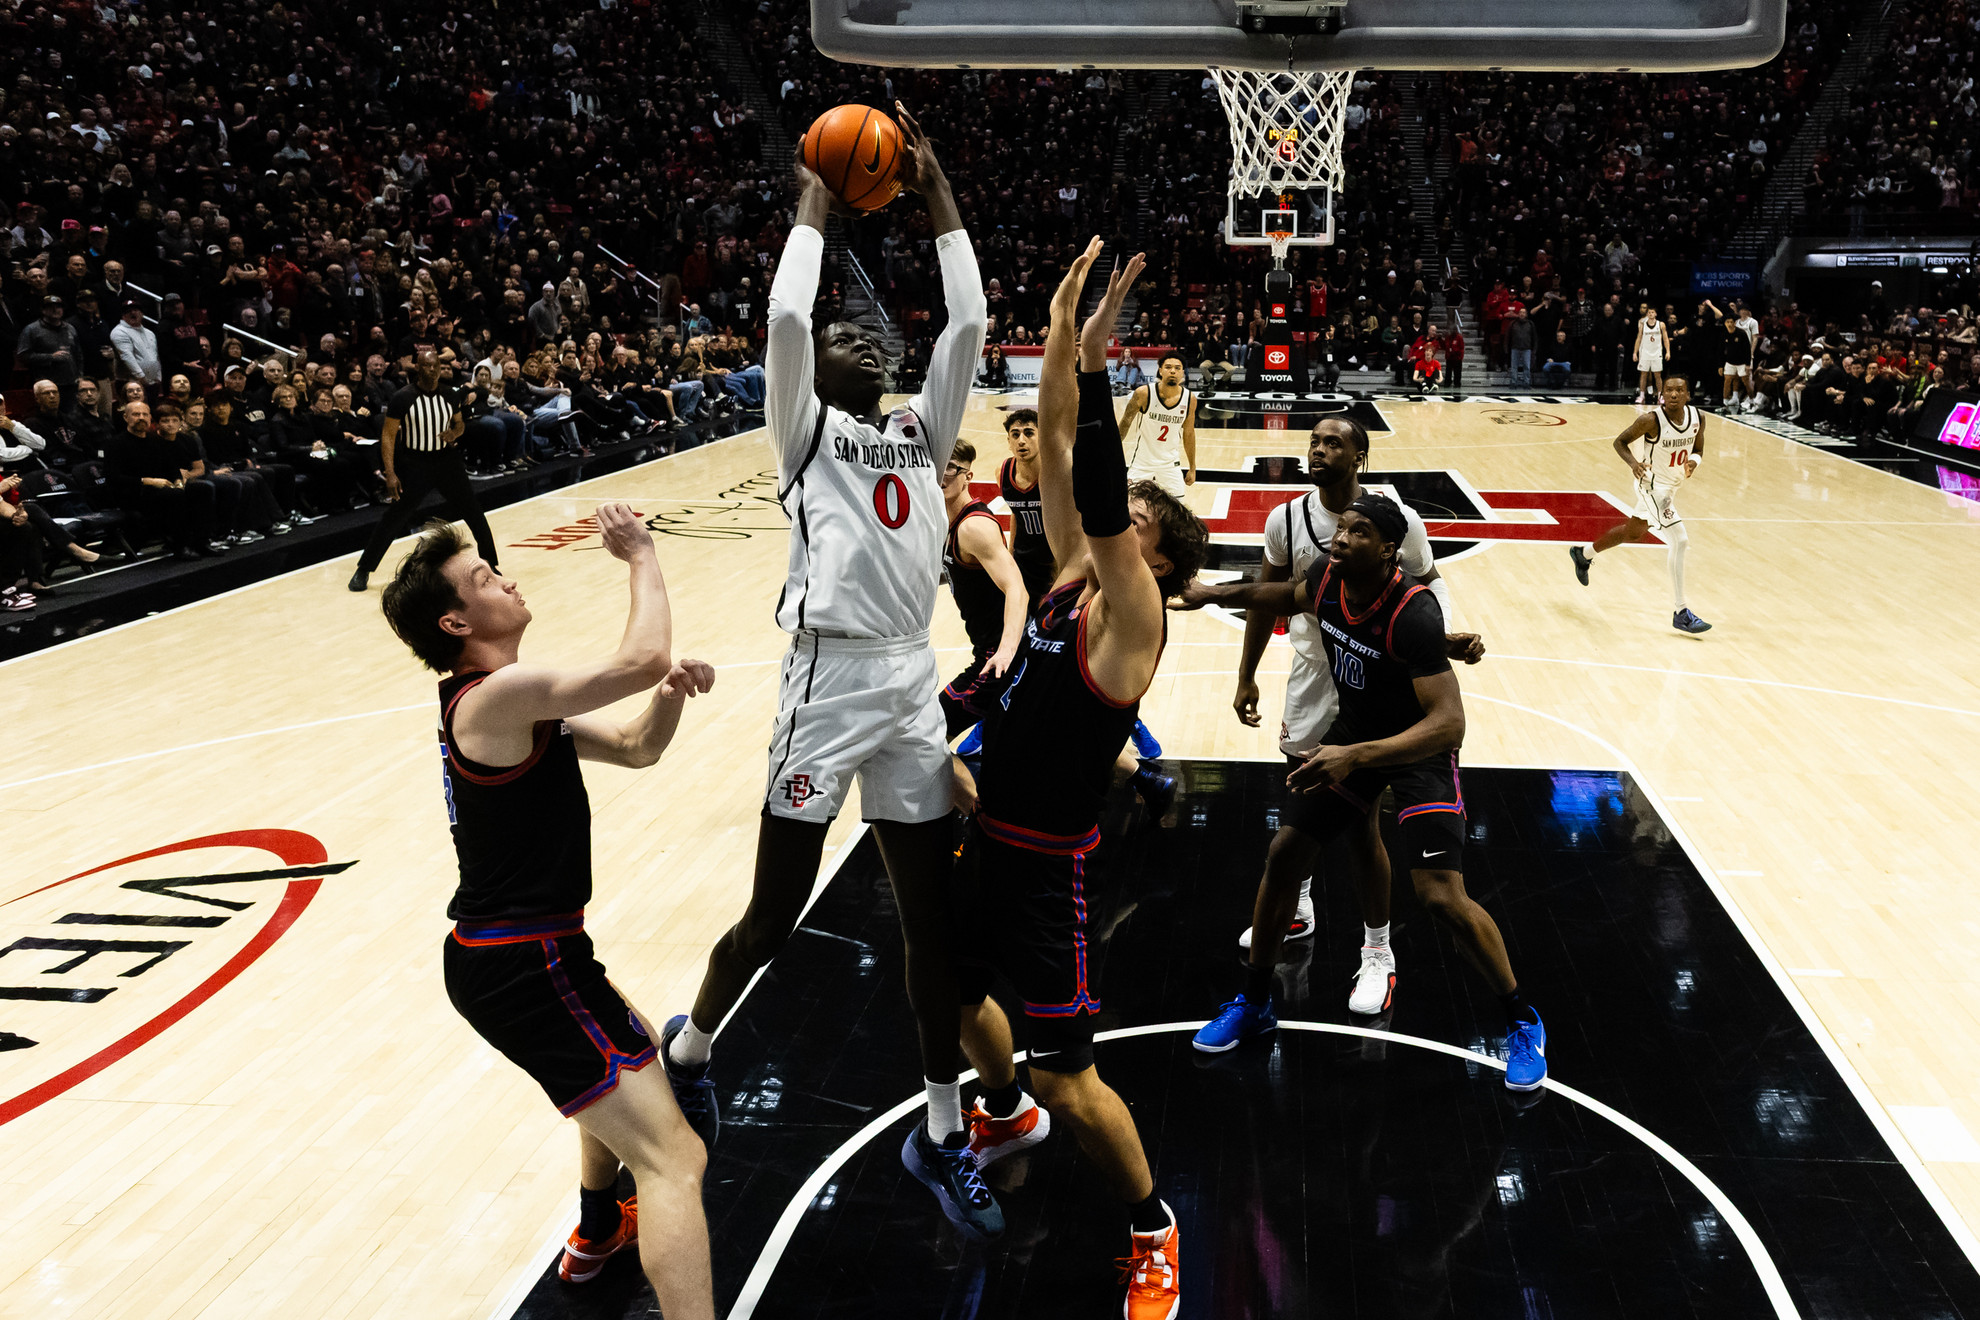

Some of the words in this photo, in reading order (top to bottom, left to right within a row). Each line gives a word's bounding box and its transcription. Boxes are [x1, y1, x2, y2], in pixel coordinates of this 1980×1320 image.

[1260, 374, 1293, 382] TOYOTA
[1149, 411, 1157, 419] SAN
[1157, 413, 1172, 424] DIEGO
[1157, 425, 1169, 442] 2
[1662, 439, 1671, 448] SAN
[1672, 437, 1686, 447] DIEGO
[834, 436, 859, 463] SAN
[861, 444, 896, 470] DIEGO
[1668, 449, 1689, 467] 10
[873, 473, 911, 529] 0
[1020, 510, 1043, 535] 11
[1030, 637, 1065, 653] TATE
[1320, 618, 1349, 644] BOISE
[1348, 637, 1381, 660] STATE
[1333, 643, 1366, 690] 10
